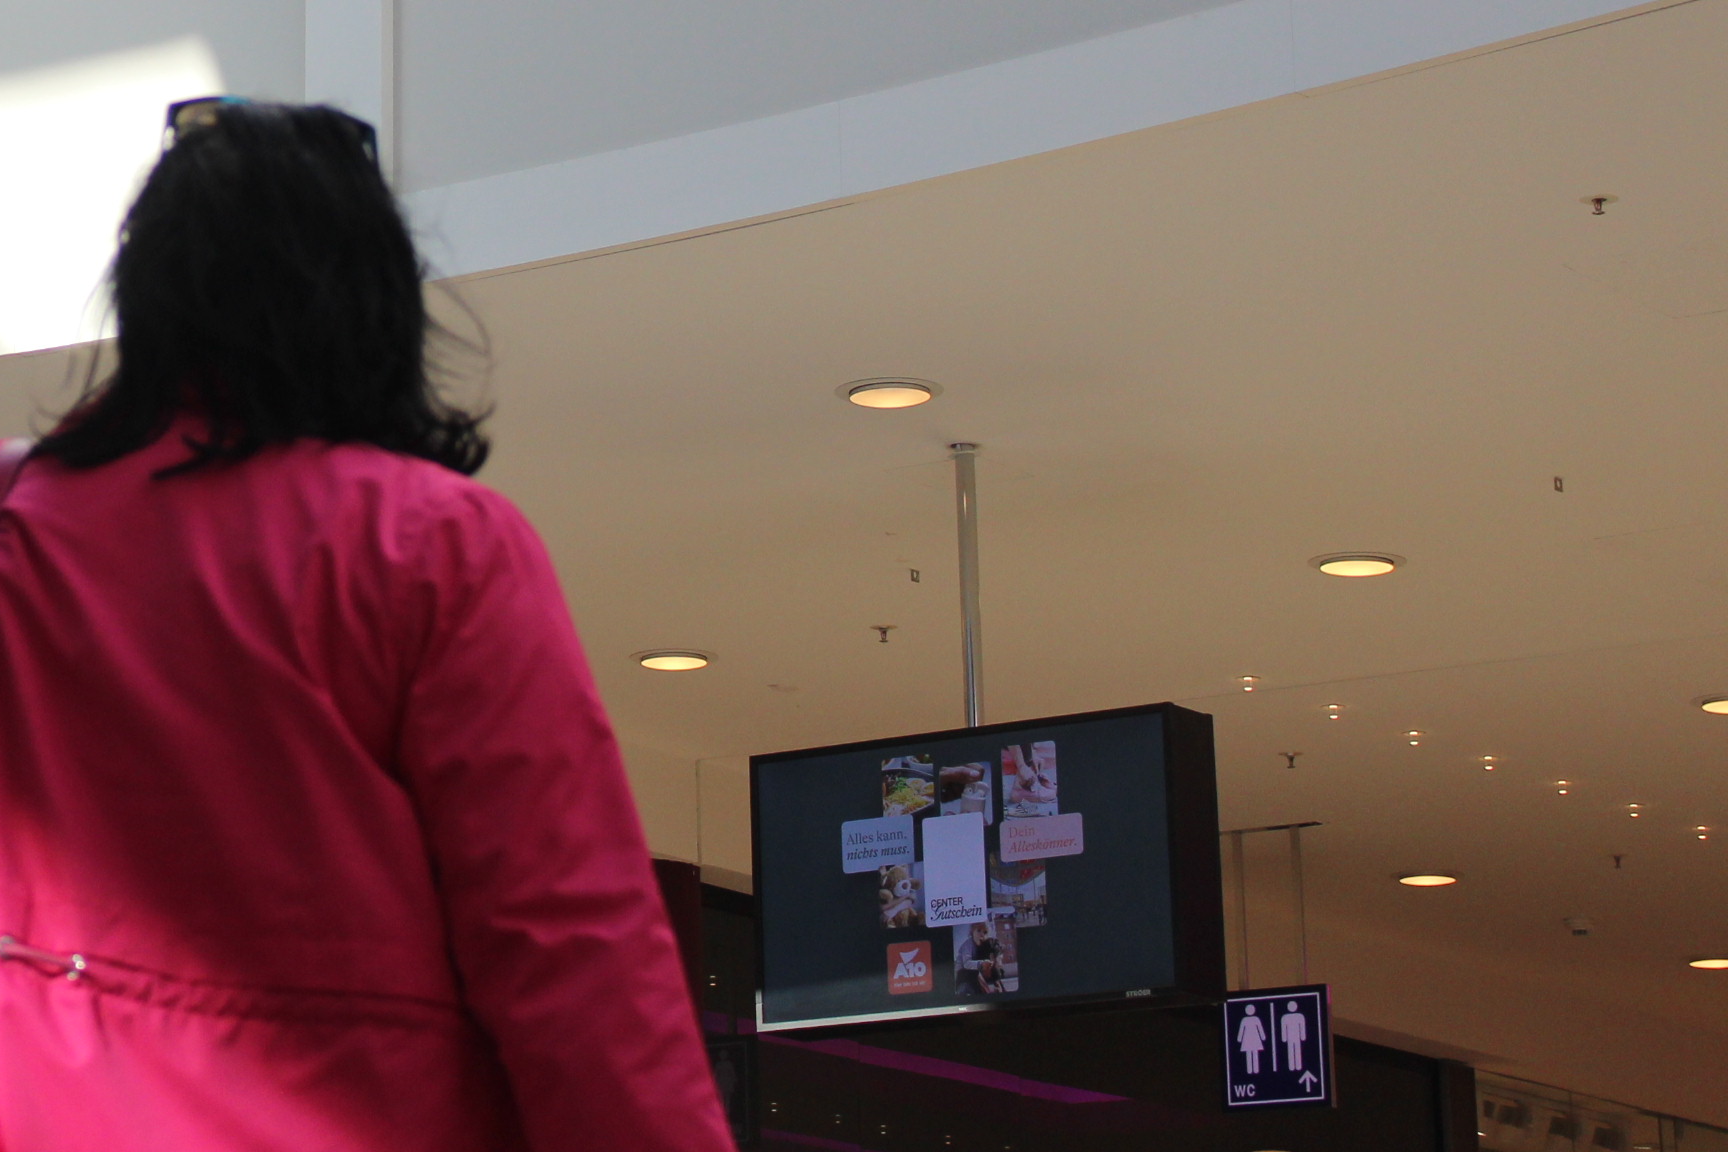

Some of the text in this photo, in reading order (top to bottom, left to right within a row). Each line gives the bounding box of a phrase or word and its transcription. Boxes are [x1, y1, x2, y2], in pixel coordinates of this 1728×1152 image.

[846, 832, 874, 846] Alles
[1009, 826, 1035, 838] Dein
[1009, 837, 1078, 853] Alleskönner.
[847, 845, 910, 861] nichts muss.
[930, 896, 964, 908] CENTER
[893, 961, 927, 979] A10
[1234, 1083, 1256, 1097] WC
